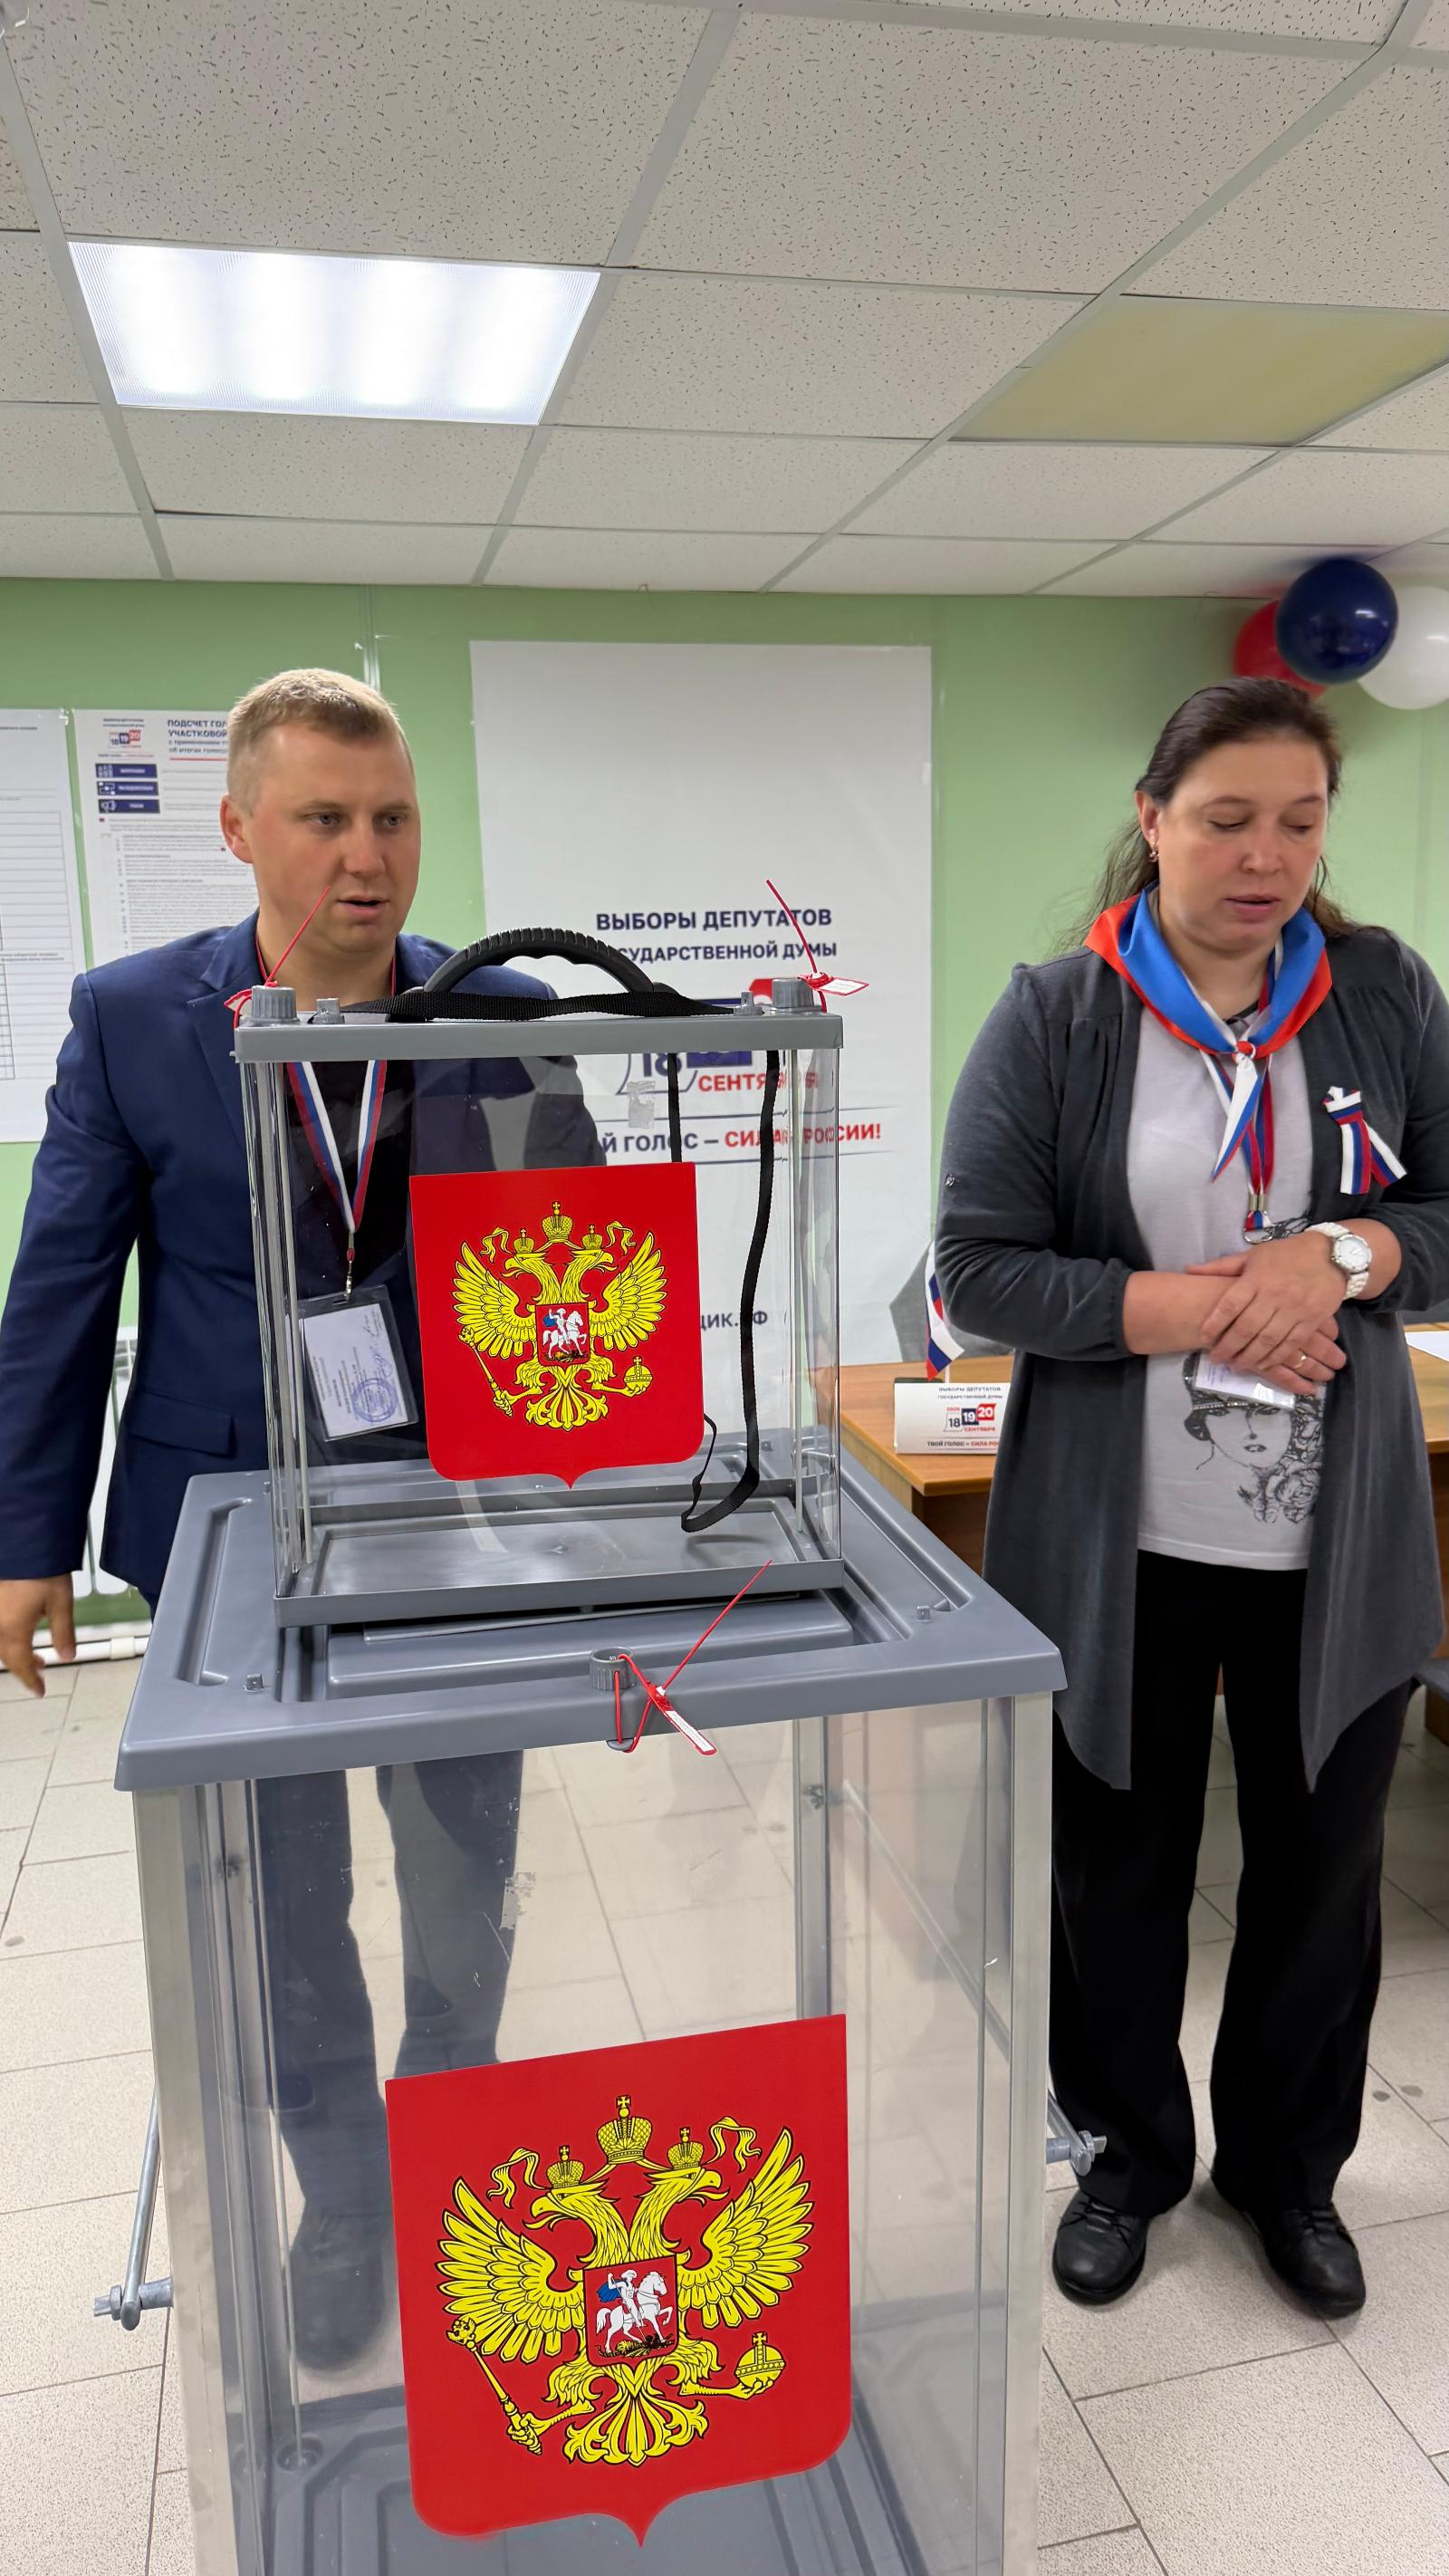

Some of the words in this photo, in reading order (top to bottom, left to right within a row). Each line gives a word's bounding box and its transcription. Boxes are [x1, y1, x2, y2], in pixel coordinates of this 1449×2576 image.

[168, 719, 208, 727] ПОДСЧЕТ
[210, 720, 227, 728] ГОЛ
[168, 728, 227, 738] УЧАСТКОВОЙ
[596, 912, 696, 931] ВЫБОРЫ
[703, 908, 832, 931] ДЕПУТАТОВ
[619, 940, 778, 964] УДАРСТВЕННОЙ
[782, 942, 837, 960] ДУМЫ
[623, 1132, 698, 1153] ГОЛС
[700, 1310, 768, 1331] ИК.Ф
[948, 1418, 960, 1427] 18
[963, 1411, 975, 1422] 19
[978, 1407, 993, 1418] 20
